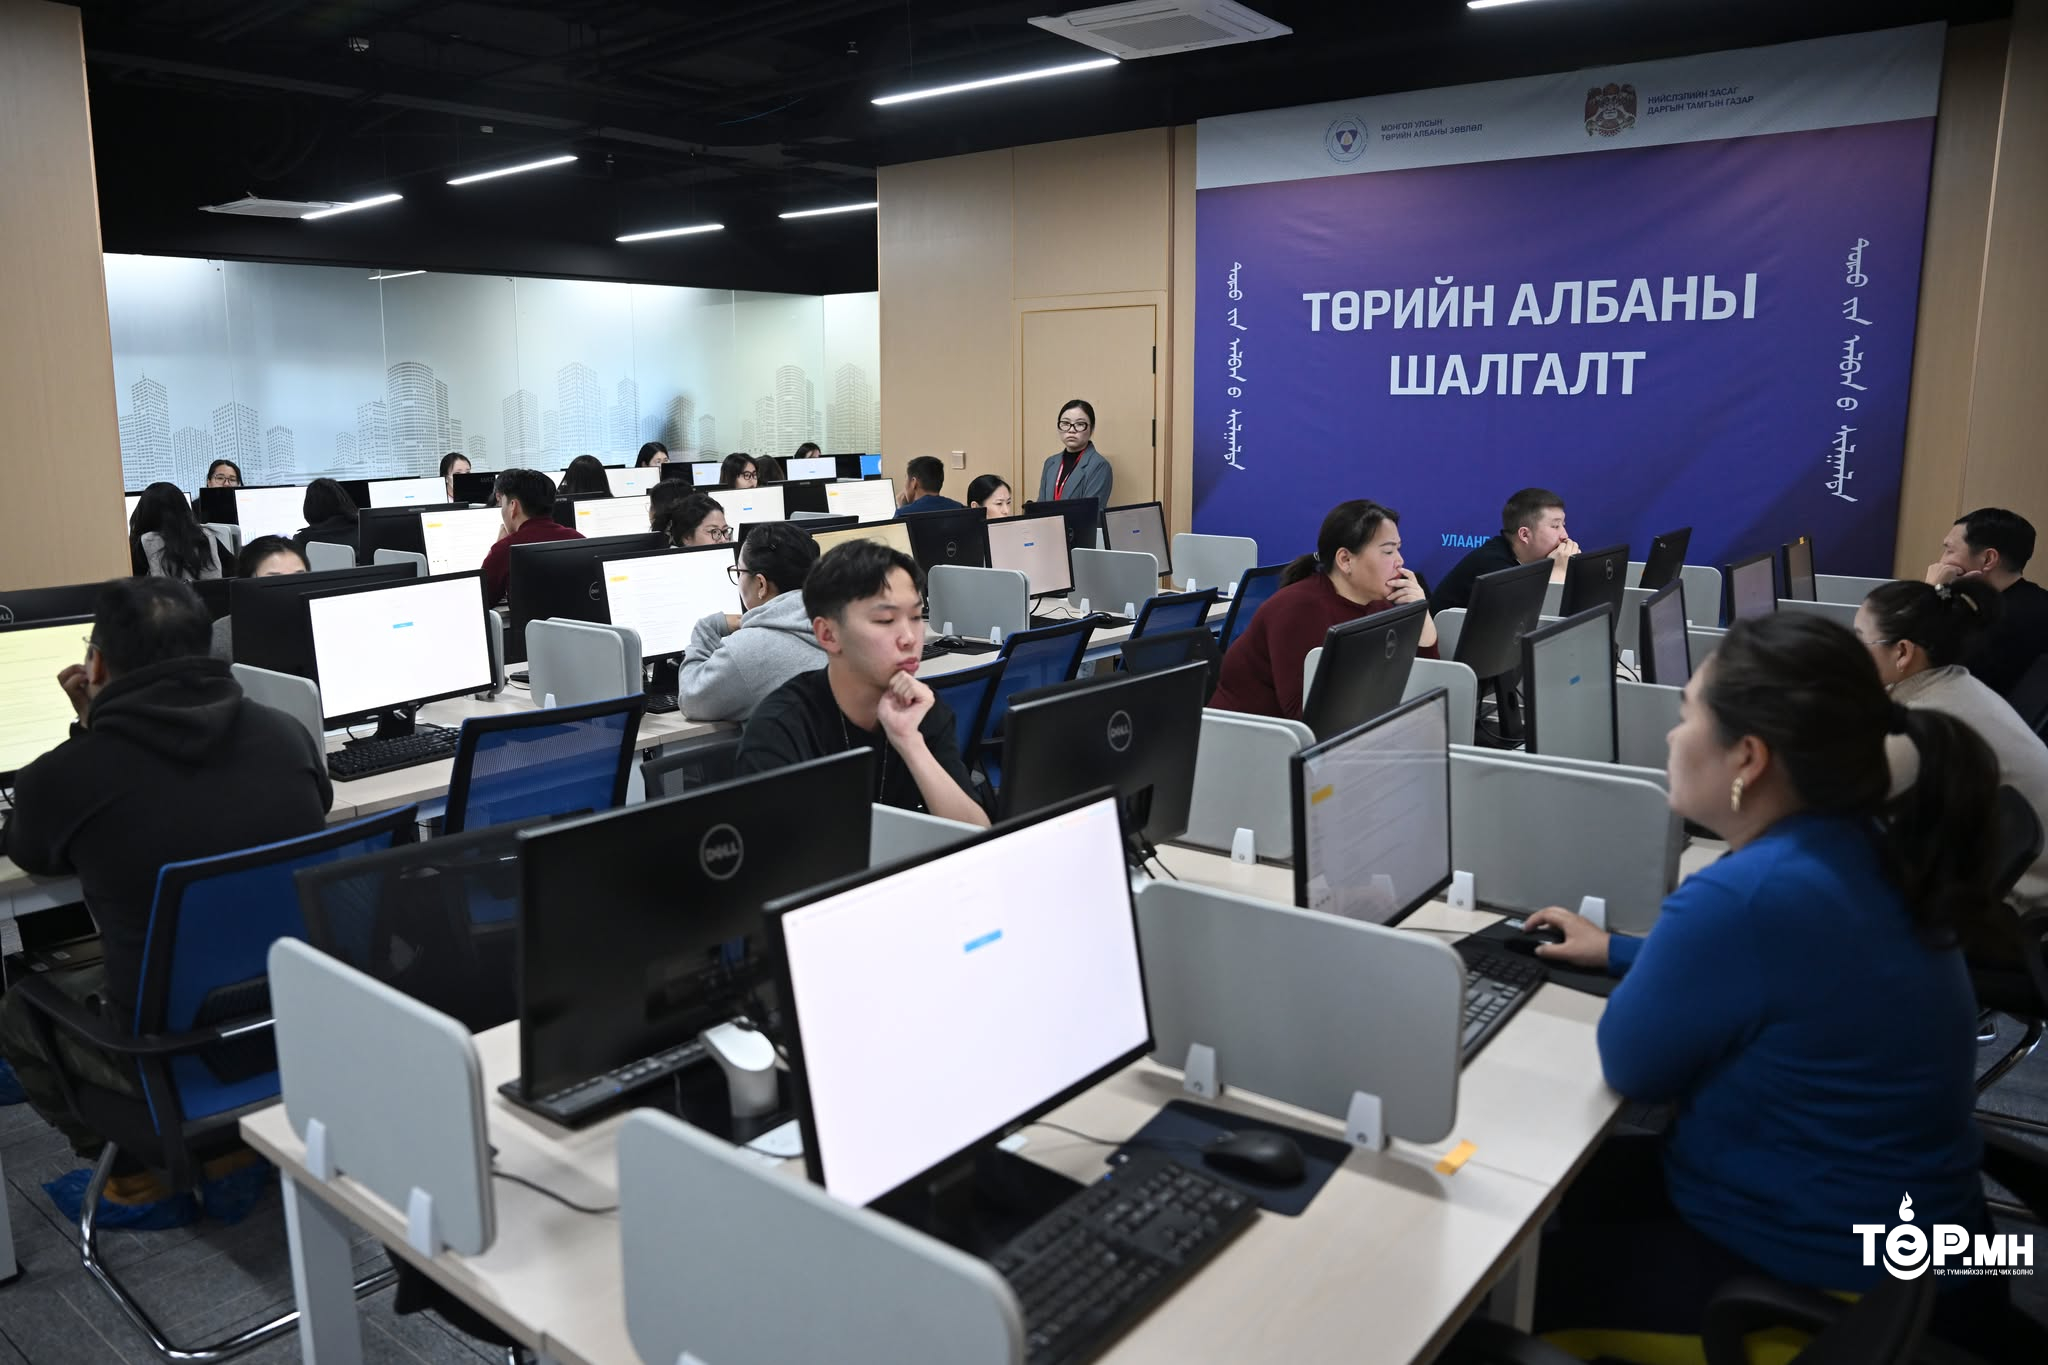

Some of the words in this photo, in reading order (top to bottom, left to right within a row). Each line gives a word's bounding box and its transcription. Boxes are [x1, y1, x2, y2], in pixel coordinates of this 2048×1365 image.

[1709, 86, 1740, 97] ЗАСАГ
[1648, 103, 1684, 115] ДАРГЫН
[1686, 99, 1724, 110] ТАМГЫН
[1725, 95, 1755, 106] ГАЗАР
[1381, 121, 1413, 132] МОНГОЛ
[1414, 119, 1443, 129] УЛСЫН
[1381, 130, 1412, 142] ТӨРИЙН
[1413, 127, 1448, 138] АЛБАНЫ
[1449, 123, 1483, 135] ЗӨВЛӨЛ
[1302, 275, 1495, 332] ТӨРИЙН
[1507, 272, 1758, 326] АЛБАНЫ
[1389, 351, 1647, 396] ШАЛГАЛТ
